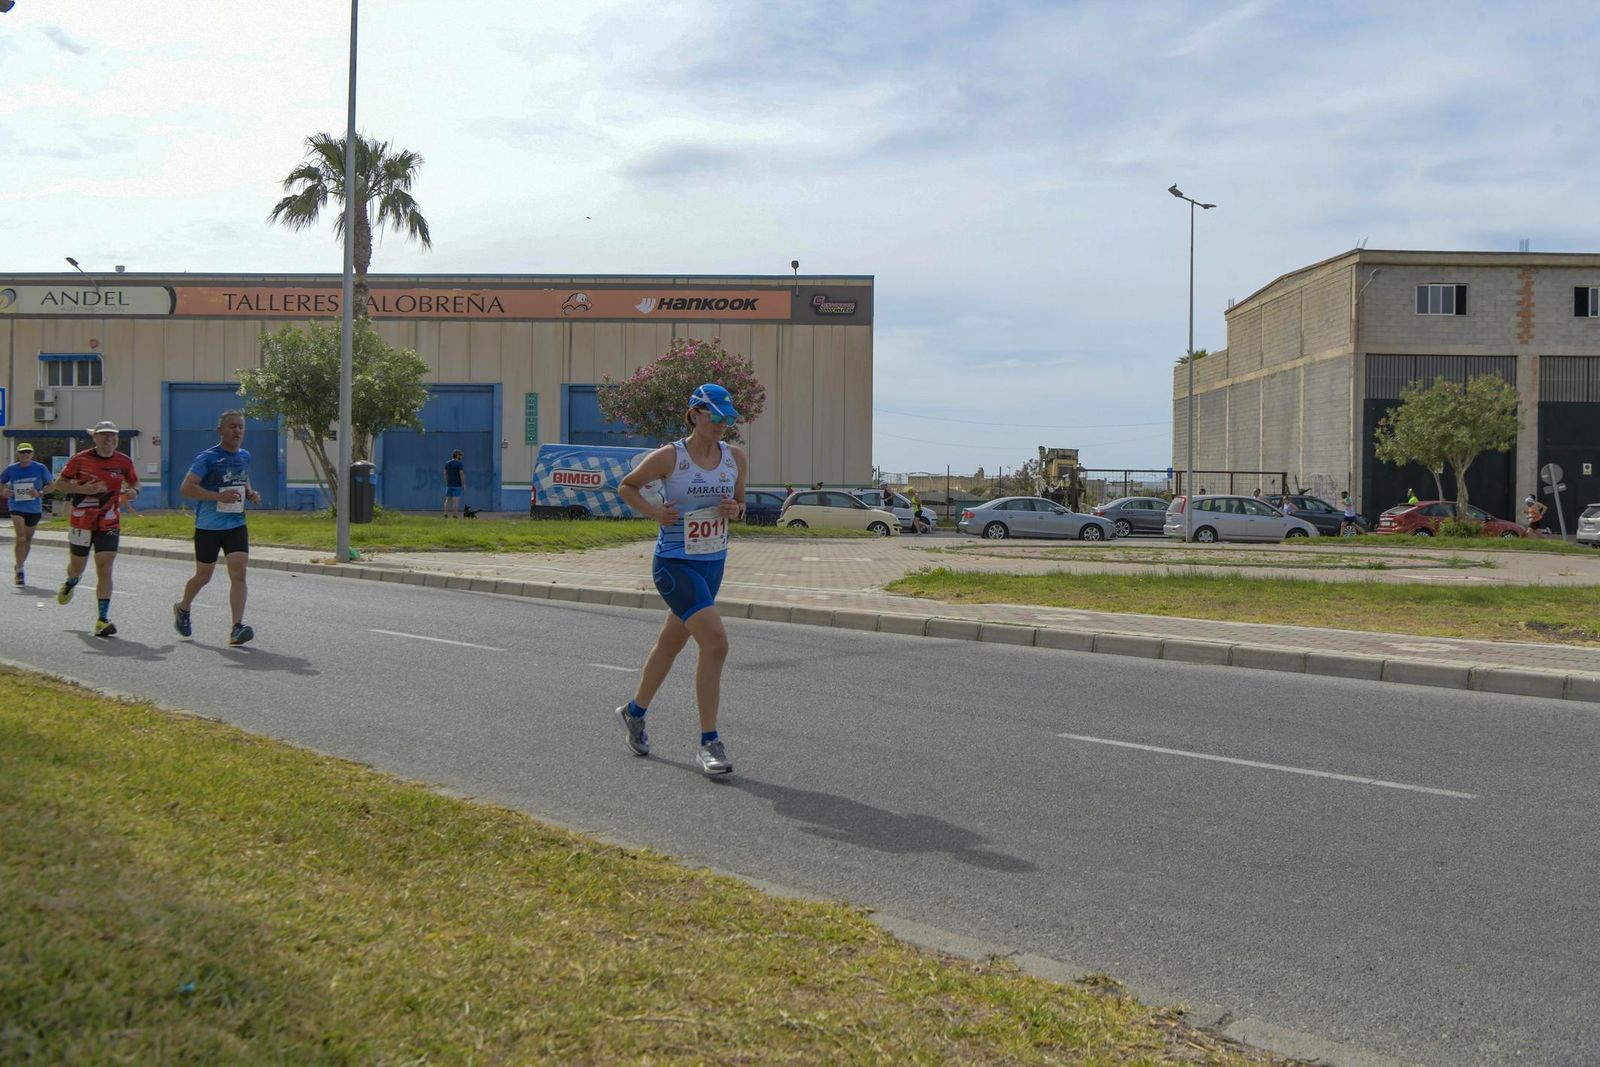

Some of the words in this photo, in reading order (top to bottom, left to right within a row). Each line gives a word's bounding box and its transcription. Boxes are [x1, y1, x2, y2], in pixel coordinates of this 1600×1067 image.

[41, 291, 129, 306] ANDEL
[222, 293, 340, 313] TALLERES
[364, 292, 505, 314] ALOBREÑA
[552, 472, 601, 485] BIMBO
[686, 485, 734, 495] MARACEN
[688, 517, 726, 539] 2011
